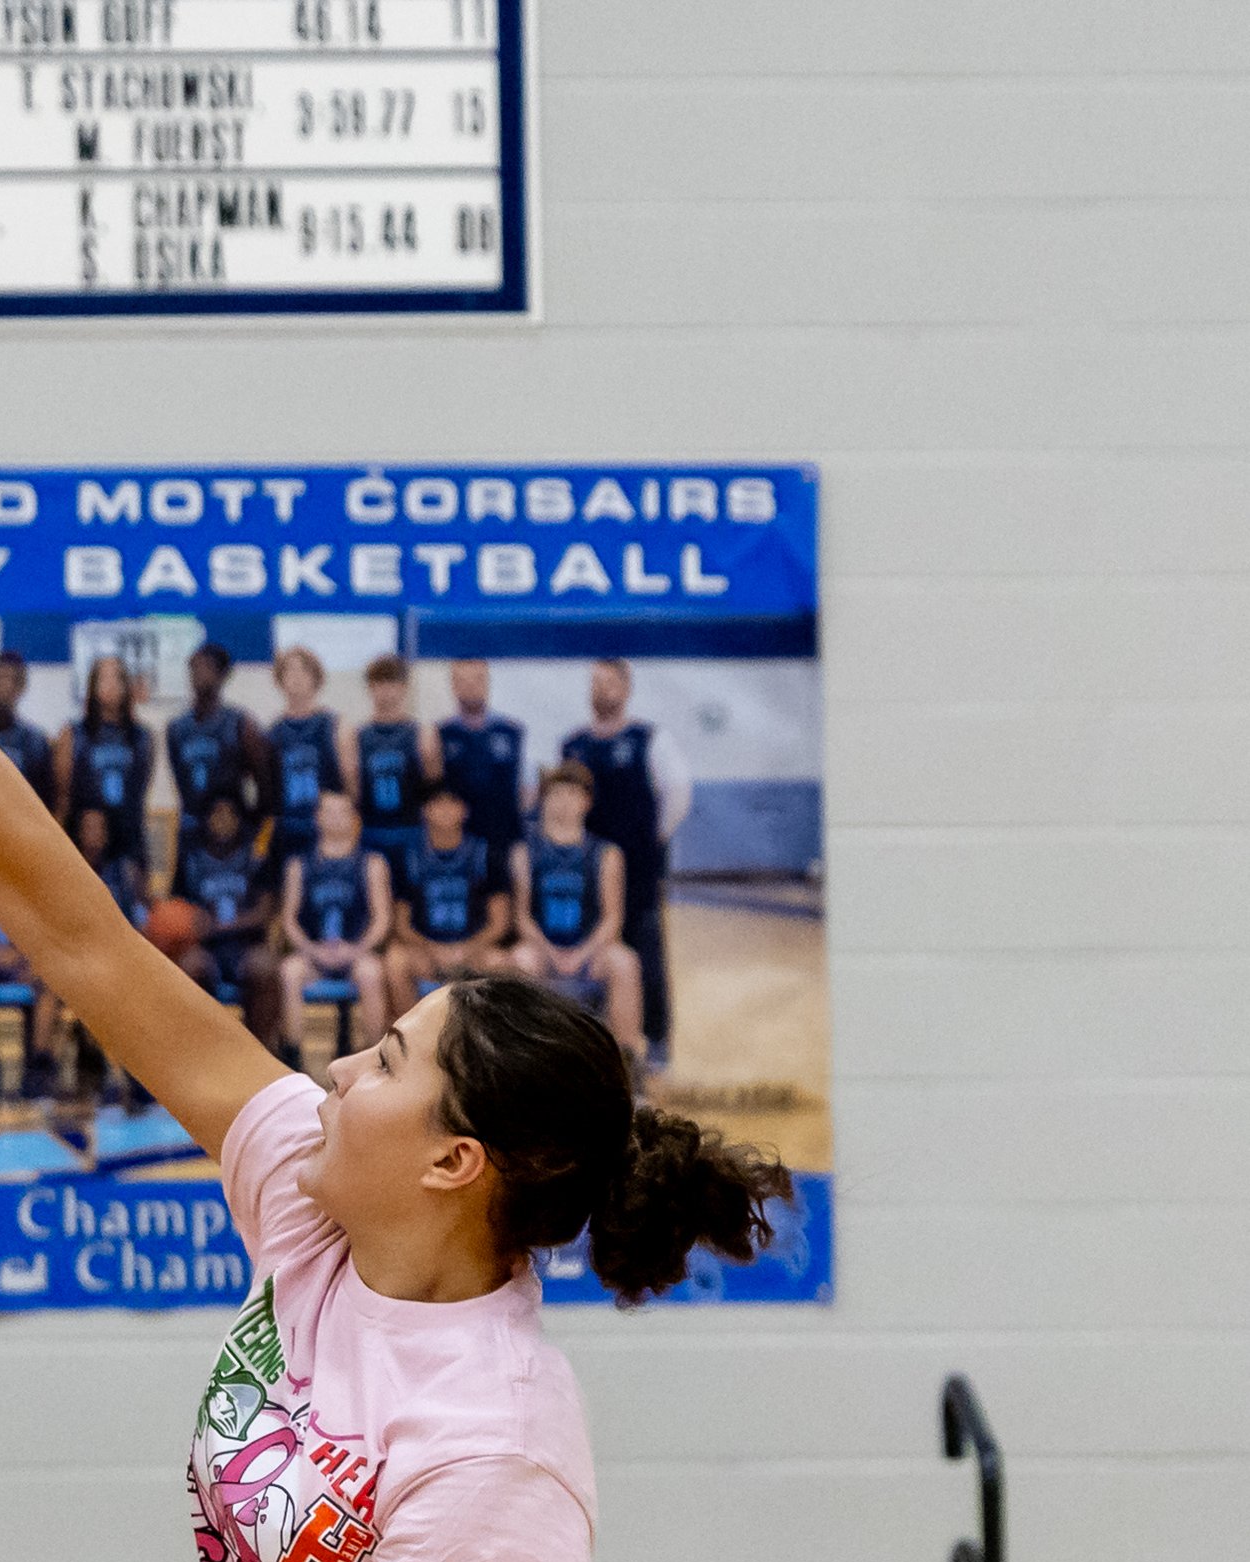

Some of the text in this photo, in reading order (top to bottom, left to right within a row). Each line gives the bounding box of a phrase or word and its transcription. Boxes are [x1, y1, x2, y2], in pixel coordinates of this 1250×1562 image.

[76, 477, 308, 526] MOTT
[344, 475, 779, 524] CORSAIRS
[62, 542, 730, 598] BASKETBALL
[16, 1182, 234, 1251] Champ
[74, 1237, 246, 1293] Cham
